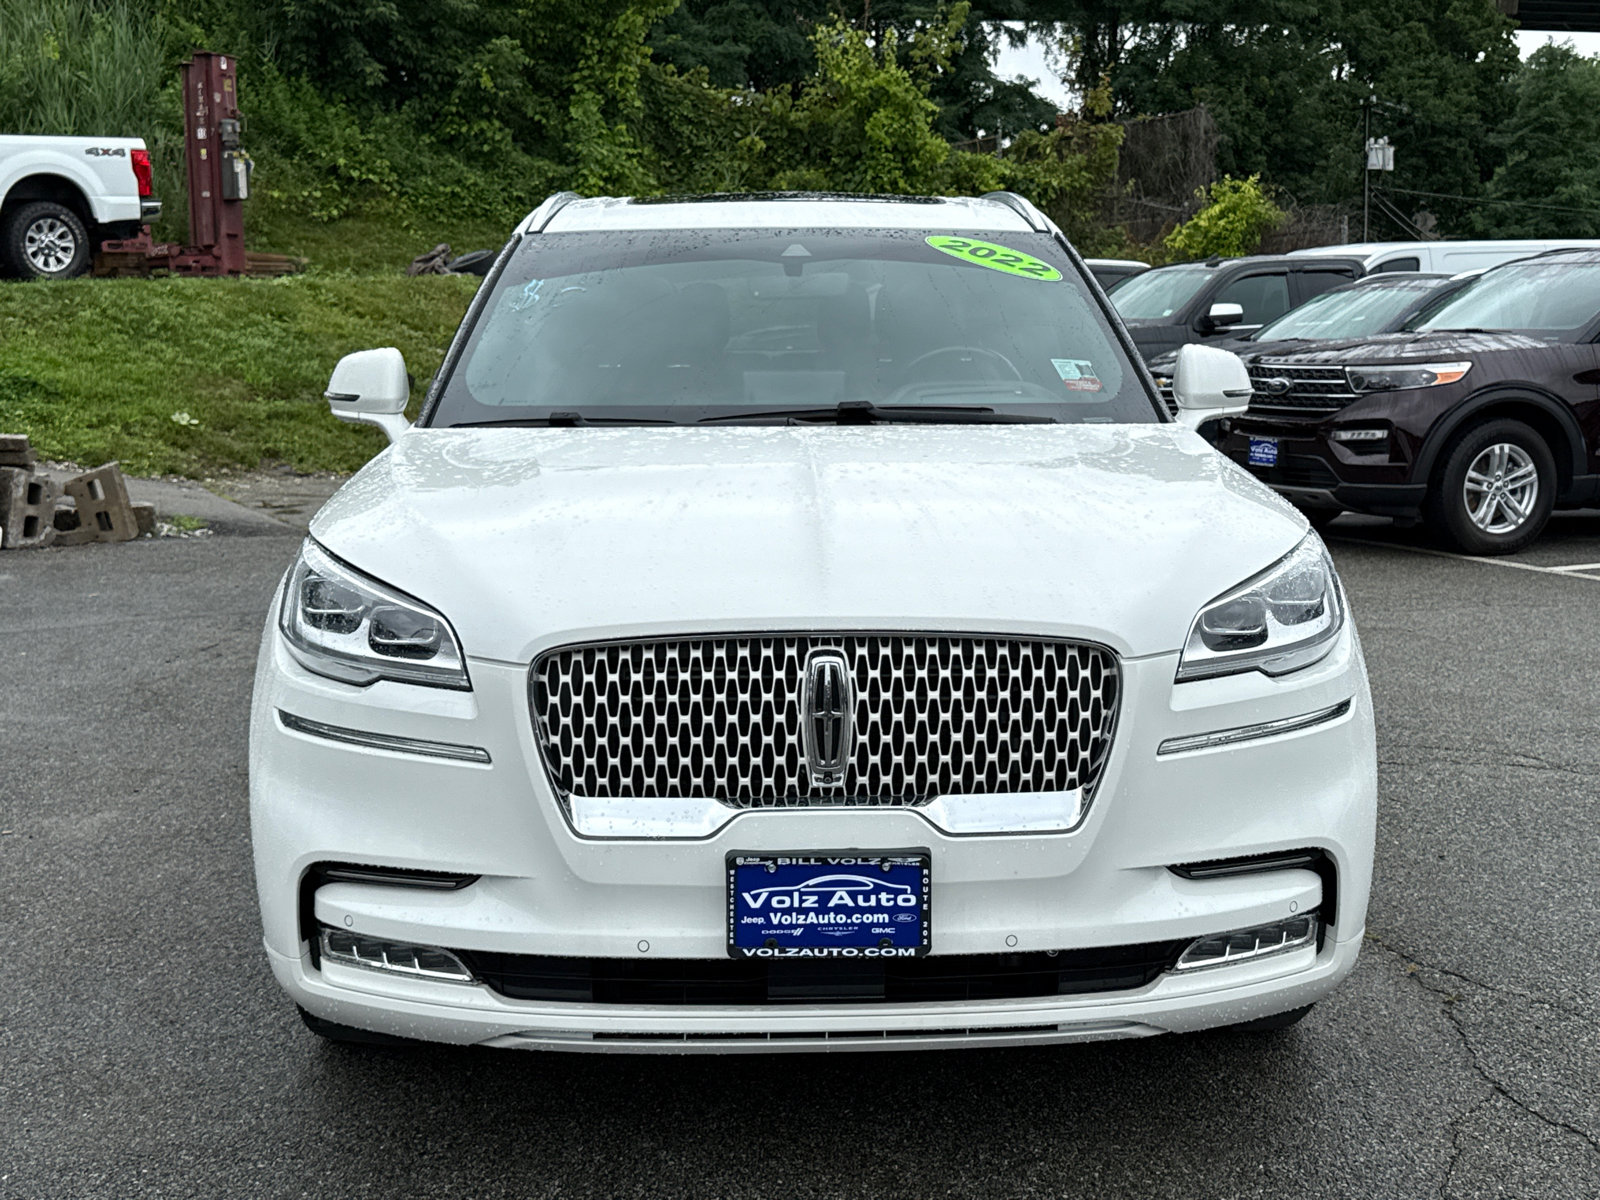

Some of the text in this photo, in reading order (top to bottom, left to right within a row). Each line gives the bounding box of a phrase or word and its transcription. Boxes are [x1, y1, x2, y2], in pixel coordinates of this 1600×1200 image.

[938, 239, 1051, 277] 2022
[777, 857, 822, 865] BILL
[827, 857, 881, 865] VOLZ
[741, 890, 917, 909] Volz Auto
[769, 911, 889, 925] VolzAuto.com
[742, 947, 916, 957] VOLZAUTO.COM
